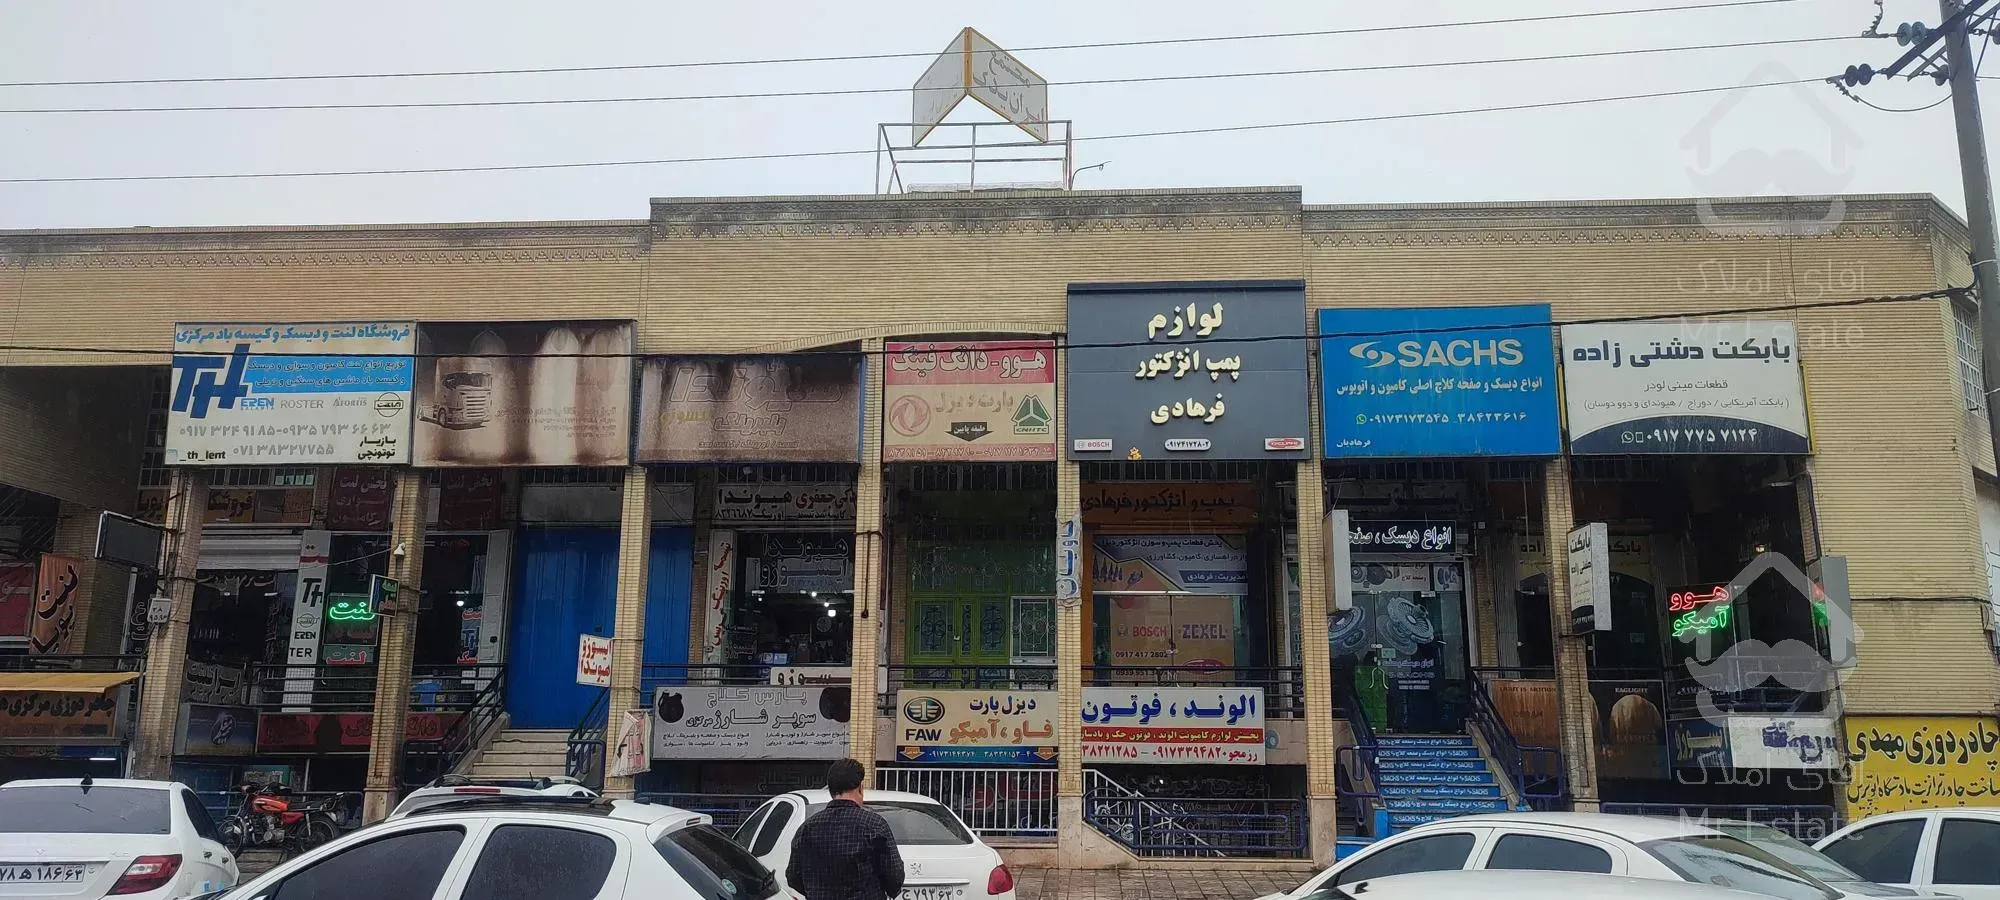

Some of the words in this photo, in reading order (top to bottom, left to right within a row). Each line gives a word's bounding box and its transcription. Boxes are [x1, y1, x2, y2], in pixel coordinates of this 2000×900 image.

[1148, 302, 1224, 339] لوازم
[175, 328, 216, 344] مرکزی
[216, 328, 233, 343] باد
[234, 327, 272, 343] کیسه
[272, 330, 280, 343] و
[280, 327, 321, 343] دیسک
[321, 330, 329, 343] و
[330, 326, 356, 338] لنت
[357, 324, 410, 341] فروشگاه
[939, 344, 989, 372] دانگ
[1397, 339, 1524, 367] SACHS
[1573, 339, 1621, 368] زاده
[1629, 338, 1704, 368] دشتی
[1712, 337, 1790, 363] بابکت
[891, 343, 938, 378] فینگ
[999, 350, 1047, 378] هوو
[1134, 347, 1200, 378] انژکتور
[1205, 354, 1241, 381] پمپ
[1336, 380, 1368, 396] اتوبوس
[1370, 384, 1376, 395] و
[1378, 379, 1407, 395] کامیون
[1409, 379, 1433, 394] اصلی
[1434, 377, 1455, 394] کلاچ
[1457, 379, 1482, 390] صفحه
[1483, 382, 1489, 393] و
[1491, 378, 1518, 391] دیسک
[1520, 377, 1543, 392] انواع
[1643, 380, 1666, 392] لودر
[1667, 381, 1693, 392] مینی
[1695, 379, 1729, 390] قطعات
[240, 397, 275, 407] EREN
[280, 399, 324, 409] ROSTER
[1150, 393, 1226, 424] فرهادی
[1336, 439, 1371, 448] فرهادیان
[1684, 429, 1716, 442] ۷۷۵
[718, 488, 793, 509] هیوندا
[1134, 488, 1187, 512] انژکتور
[1191, 498, 1199, 512] و
[1199, 498, 1235, 515] پمپ
[1381, 526, 1420, 549] دیسک
[1420, 526, 1452, 550] انواع
[1569, 531, 1592, 554] بابکت
[761, 533, 849, 562] هیوندا
[1608, 540, 1641, 556] بابک
[38, 564, 79, 620] لنت
[1668, 586, 1730, 612] هوو
[1671, 605, 1730, 637] آمیکو
[294, 631, 317, 640] EREN
[1132, 625, 1168, 637] BOSCH
[1181, 624, 1227, 639] ZEXEL
[582, 637, 613, 660] ایسوزو
[326, 650, 367, 665] لنت
[580, 659, 612, 683] هیوندا
[706, 687, 750, 709] کلاچ
[754, 688, 807, 706] پارس
[969, 695, 1000, 715] پارت
[1001, 695, 1037, 715] دیزل
[1081, 692, 1162, 725] فوتون
[1183, 693, 1257, 725] الوند
[685, 714, 713, 728] مرکزی
[712, 708, 769, 730] شارژ
[771, 711, 817, 729] سوپر
[905, 728, 942, 742] FAW
[947, 718, 1001, 744] آمیکو
[1011, 719, 1055, 744] فاو
[1158, 731, 1178, 741] الوند
[1211, 731, 1232, 742] لوازم
[1847, 727, 1905, 762] مهدی
[1905, 726, 1956, 766] دوزی
[1957, 722, 2000, 771] چادر
[37, 866, 63, 881] ۱۸۶
[64, 868, 83, 881] ۶۳
